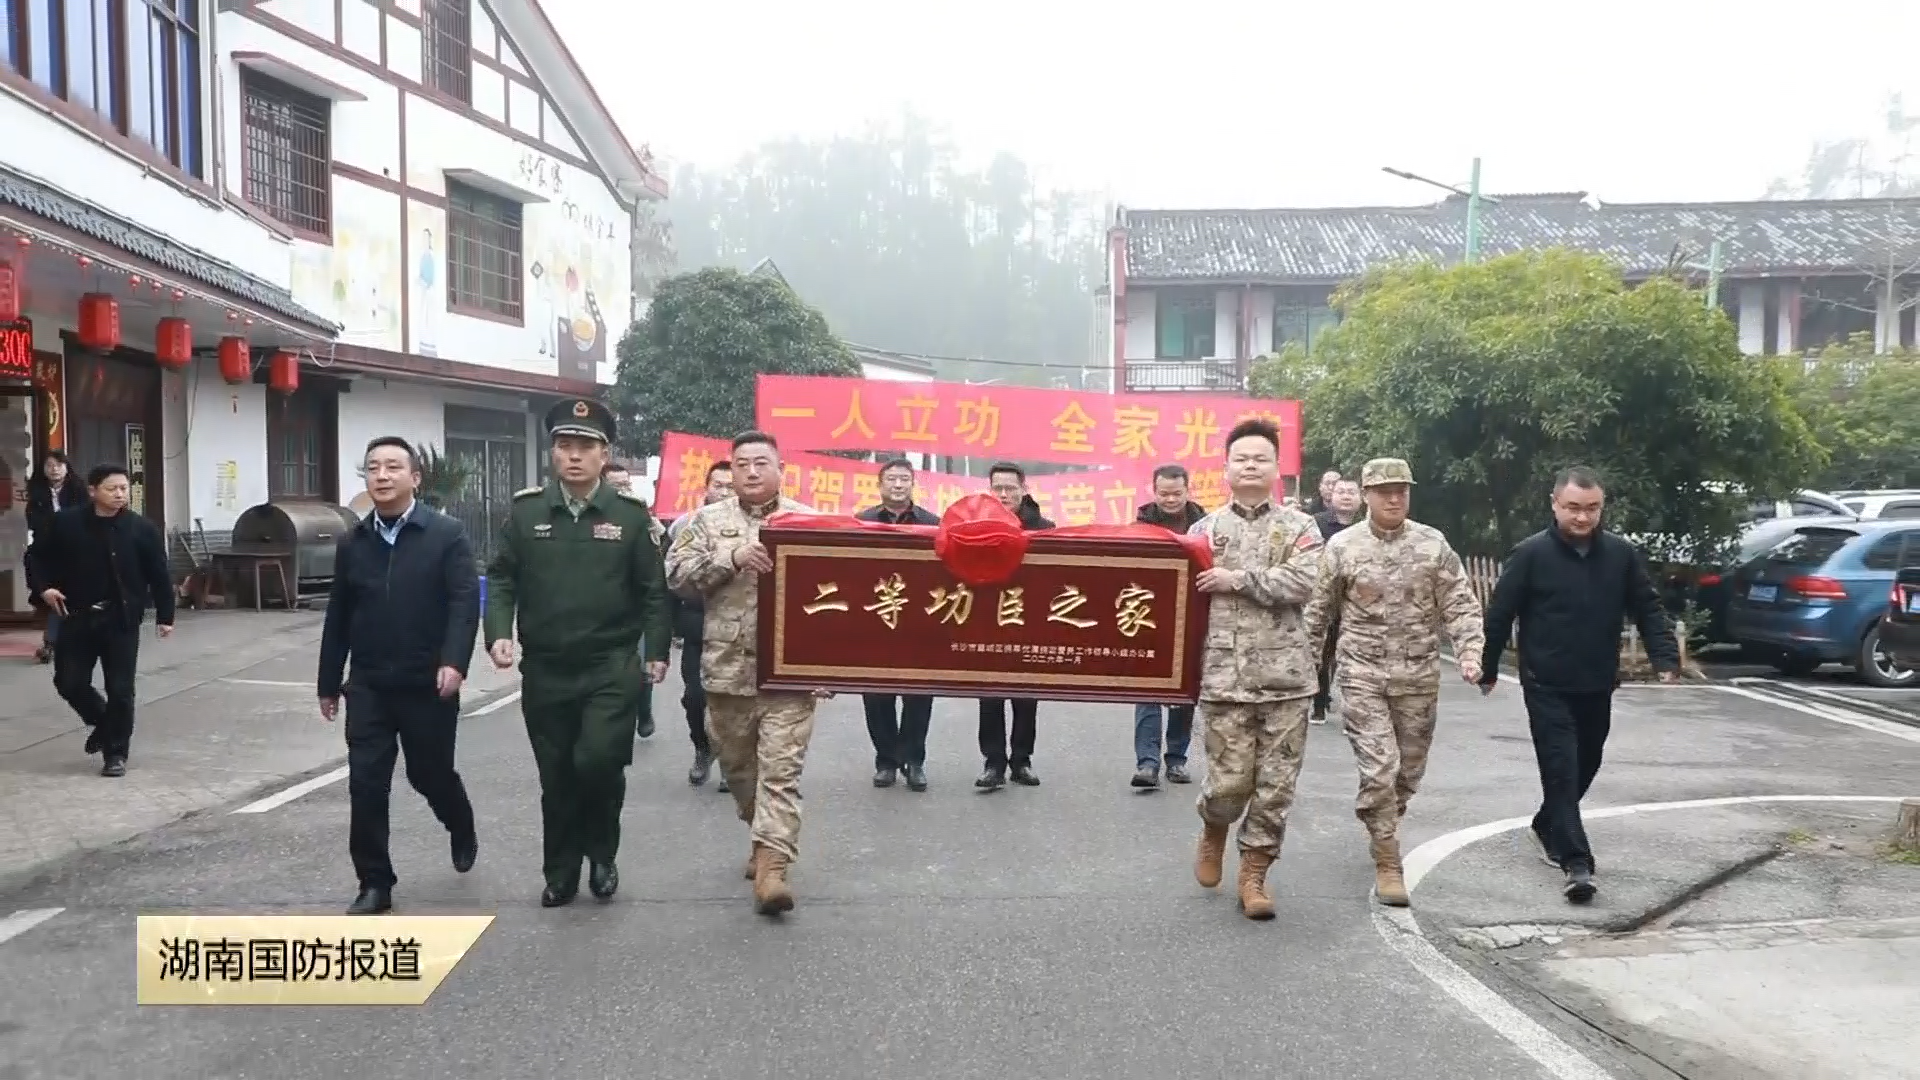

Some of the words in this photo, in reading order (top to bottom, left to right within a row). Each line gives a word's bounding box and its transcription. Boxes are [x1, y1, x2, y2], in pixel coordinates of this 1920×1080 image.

[772, 393, 1000, 448] 一人立功
[1050, 401, 1283, 459] 全家光
[802, 571, 1158, 637] 二等功臣之家
